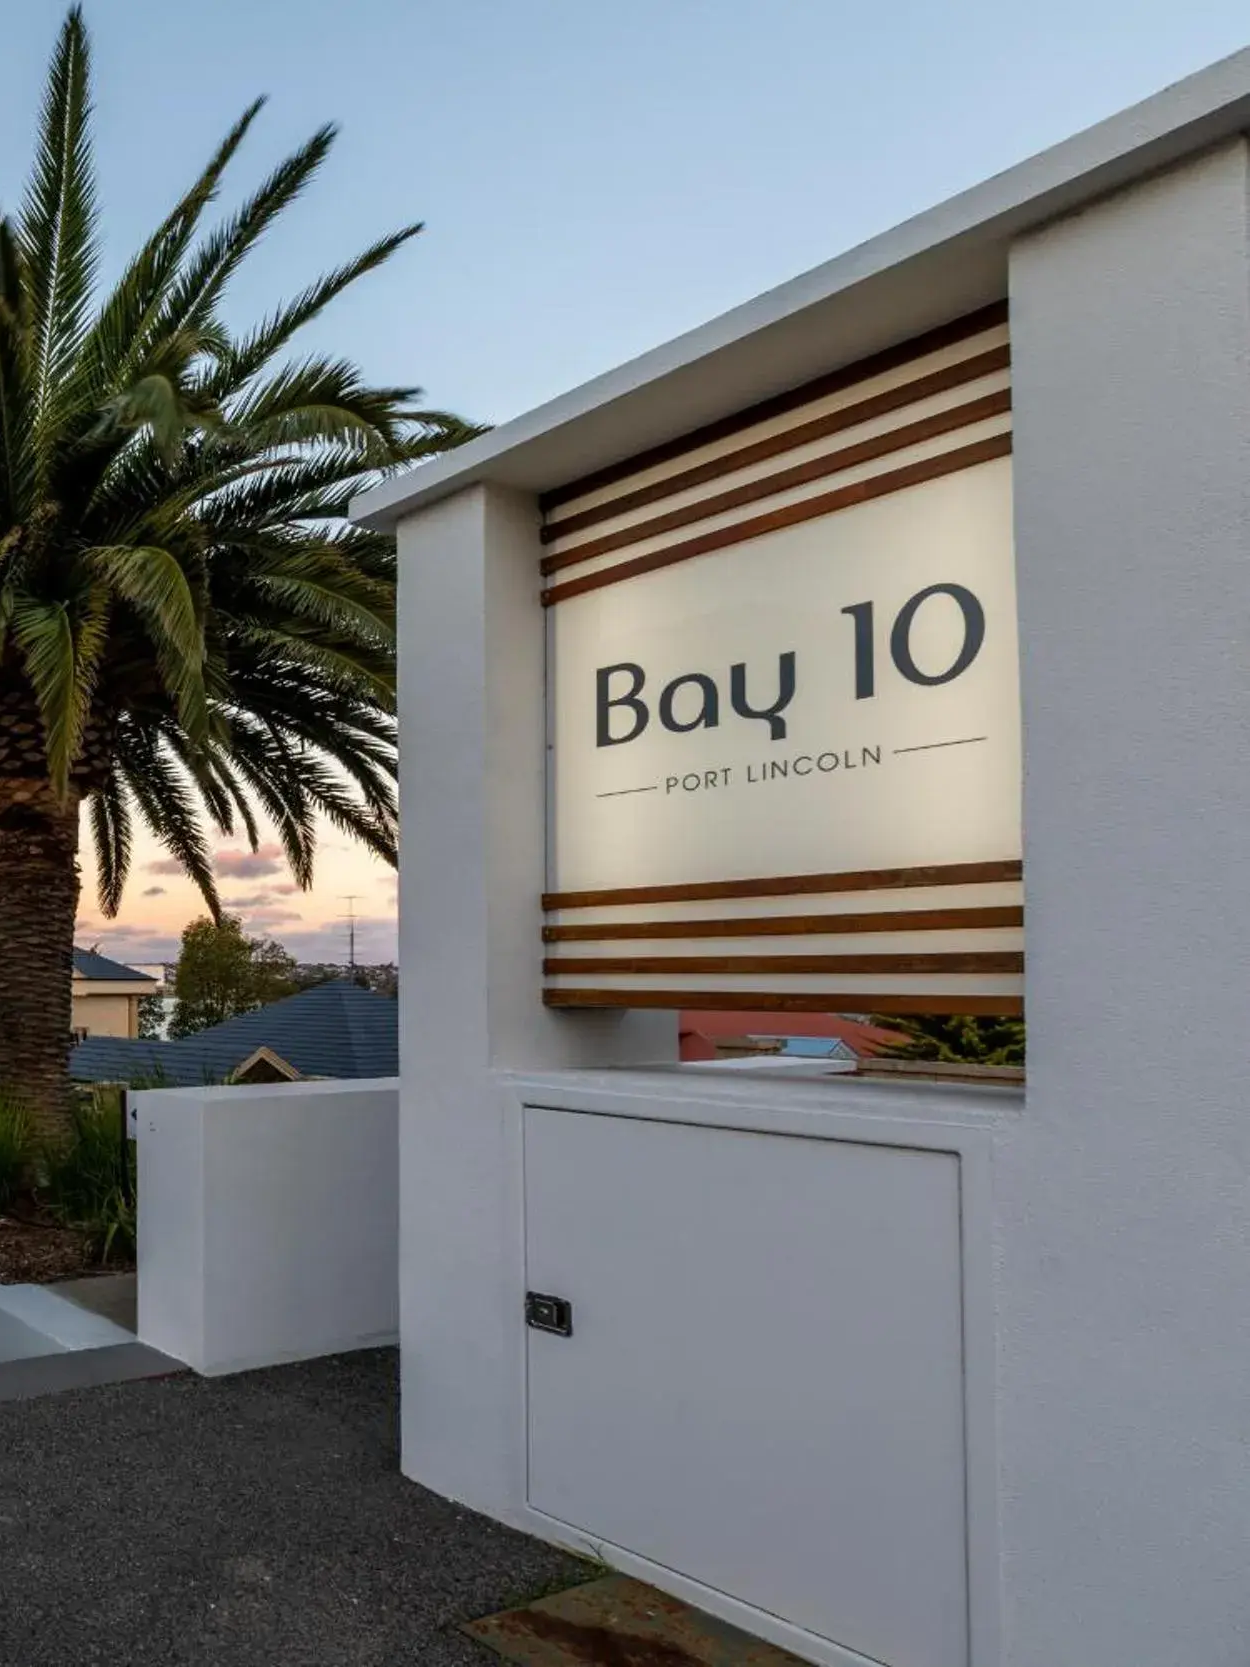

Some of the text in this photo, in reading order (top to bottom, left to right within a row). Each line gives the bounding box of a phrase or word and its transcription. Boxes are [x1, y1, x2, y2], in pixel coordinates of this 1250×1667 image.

[595, 582, 986, 748] Bay 10
[665, 745, 882, 794] PORT LINCOLN
